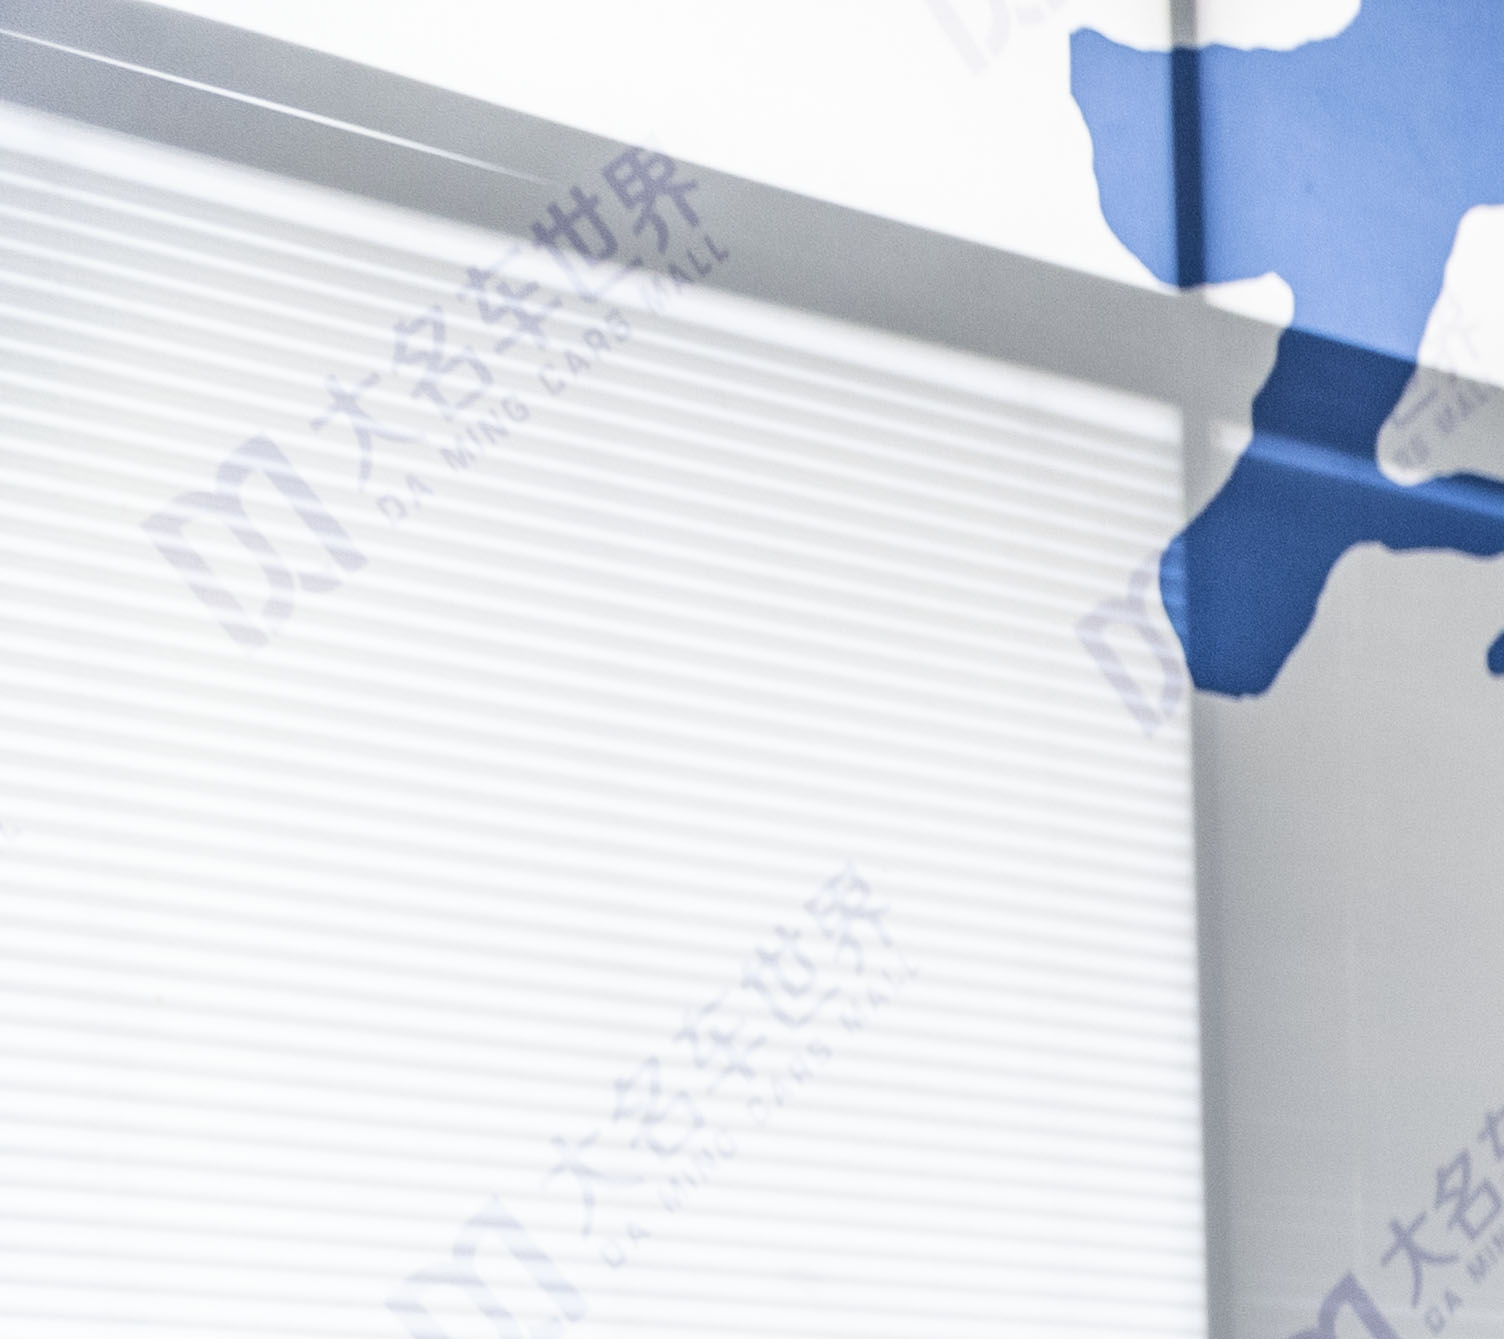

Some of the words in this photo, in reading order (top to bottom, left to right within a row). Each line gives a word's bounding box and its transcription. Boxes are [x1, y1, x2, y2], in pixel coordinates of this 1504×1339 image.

[308, 138, 700, 494] 大名车世界
[1423, 1288, 1464, 1336] DA
